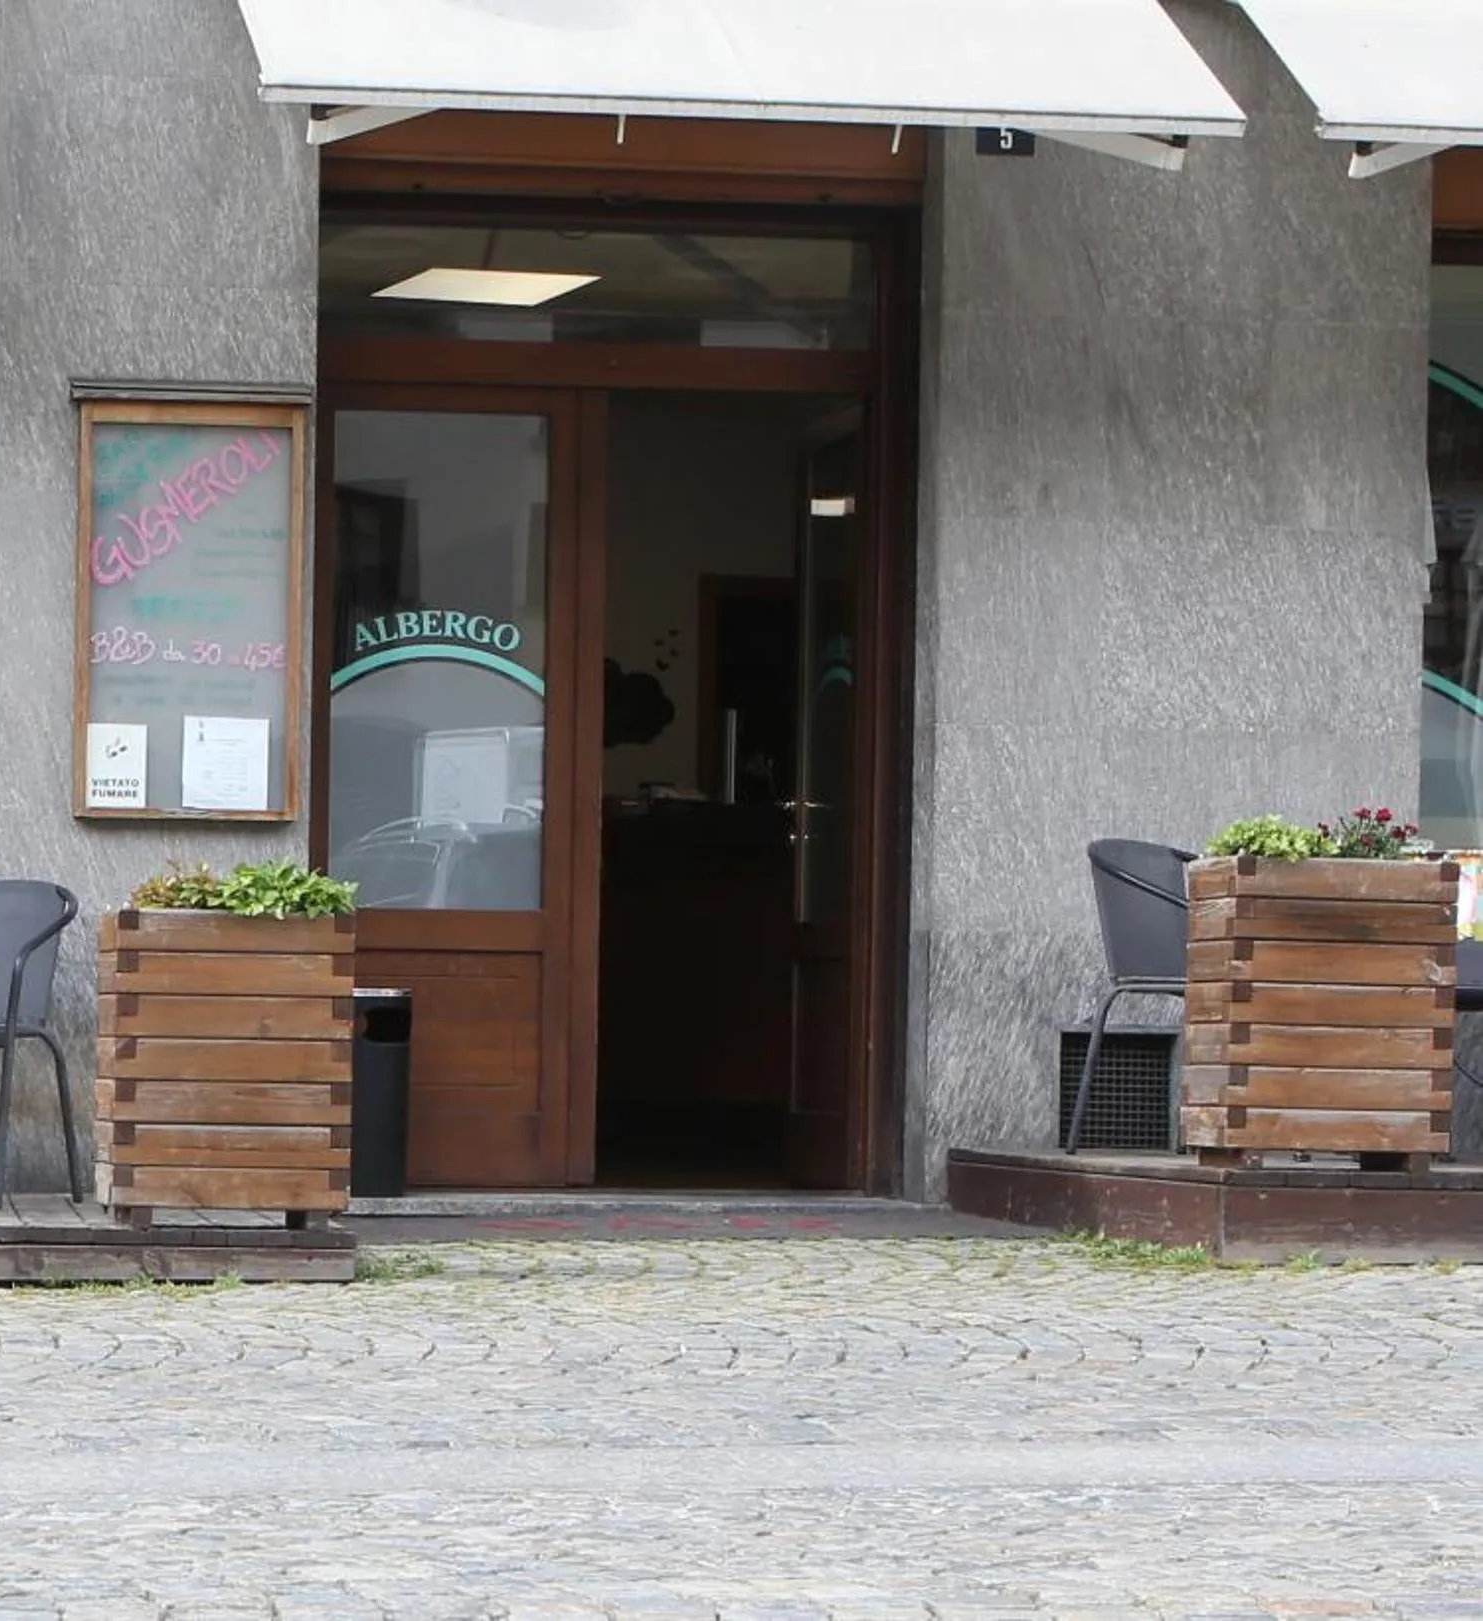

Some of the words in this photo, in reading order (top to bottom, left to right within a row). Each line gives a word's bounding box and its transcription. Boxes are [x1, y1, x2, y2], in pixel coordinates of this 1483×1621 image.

[1000, 127, 1013, 149] 5
[354, 609, 522, 651] ALBERGO
[190, 640, 223, 665] 30
[91, 778, 140, 787] VIETATO
[92, 789, 138, 798] FUMARE
